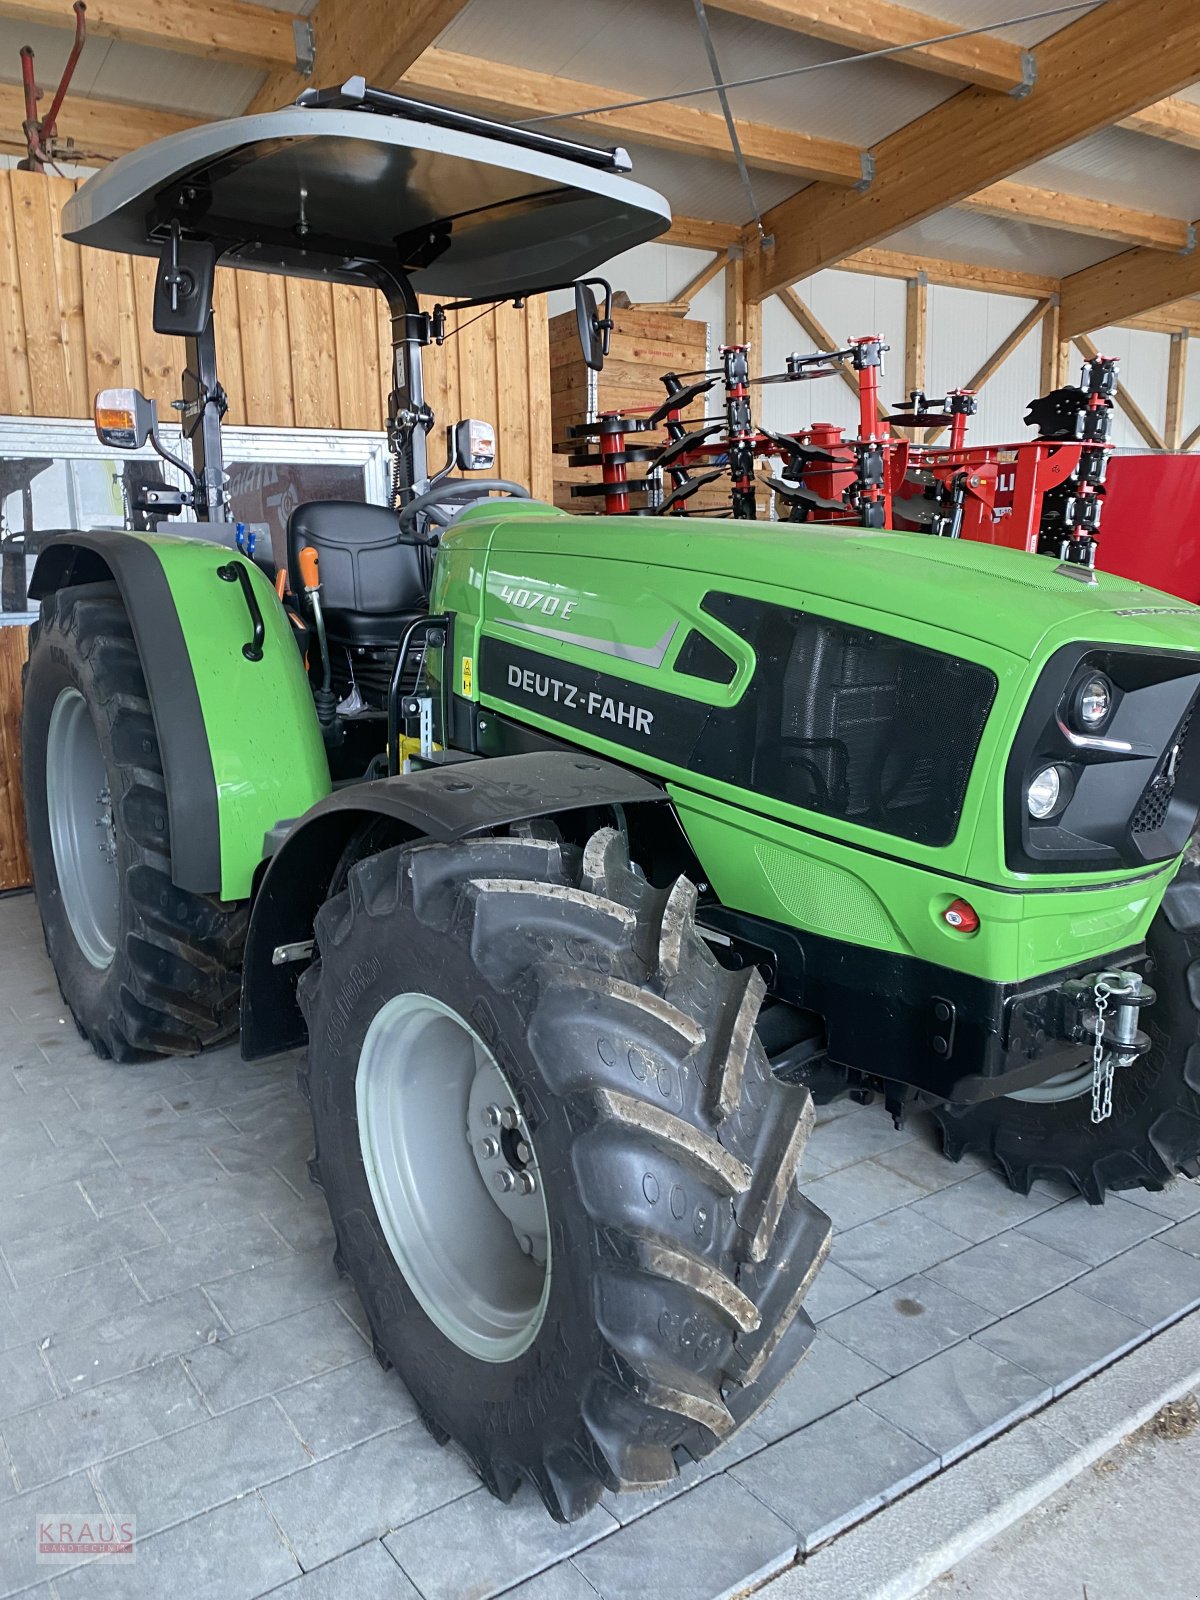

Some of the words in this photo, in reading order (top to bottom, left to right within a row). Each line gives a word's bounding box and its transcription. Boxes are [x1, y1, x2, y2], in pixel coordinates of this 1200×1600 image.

[500, 585, 558, 616] 4070
[560, 601, 578, 620] E
[508, 664, 654, 735] DEUTZ-FAHR
